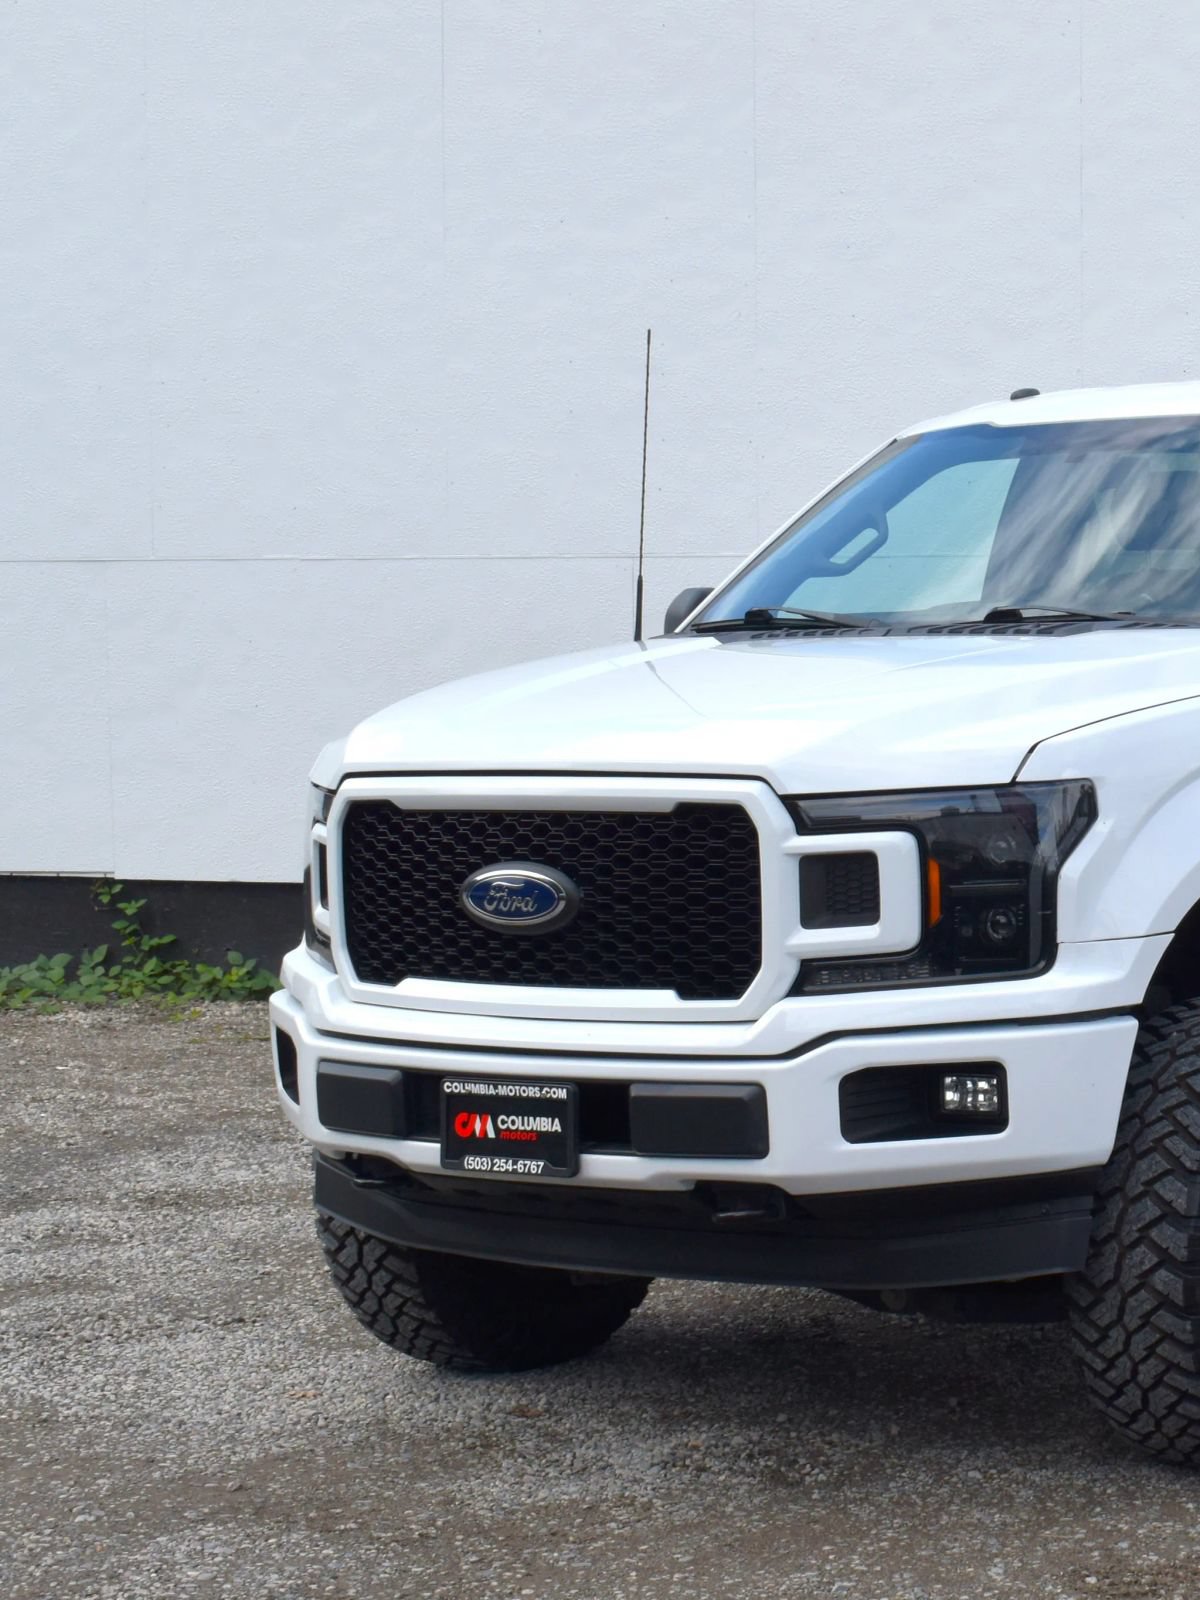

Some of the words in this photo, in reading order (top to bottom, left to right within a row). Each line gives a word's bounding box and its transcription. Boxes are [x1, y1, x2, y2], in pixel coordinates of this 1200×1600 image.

[483, 881, 540, 913] Ford
[443, 1081, 567, 1099] COLUMBIA-MOTORS.COM
[497, 1115, 562, 1132] COLUMBIA
[500, 1131, 537, 1141] motors
[464, 1156, 491, 1171] (503)
[494, 1159, 544, 1174] 254-6767
